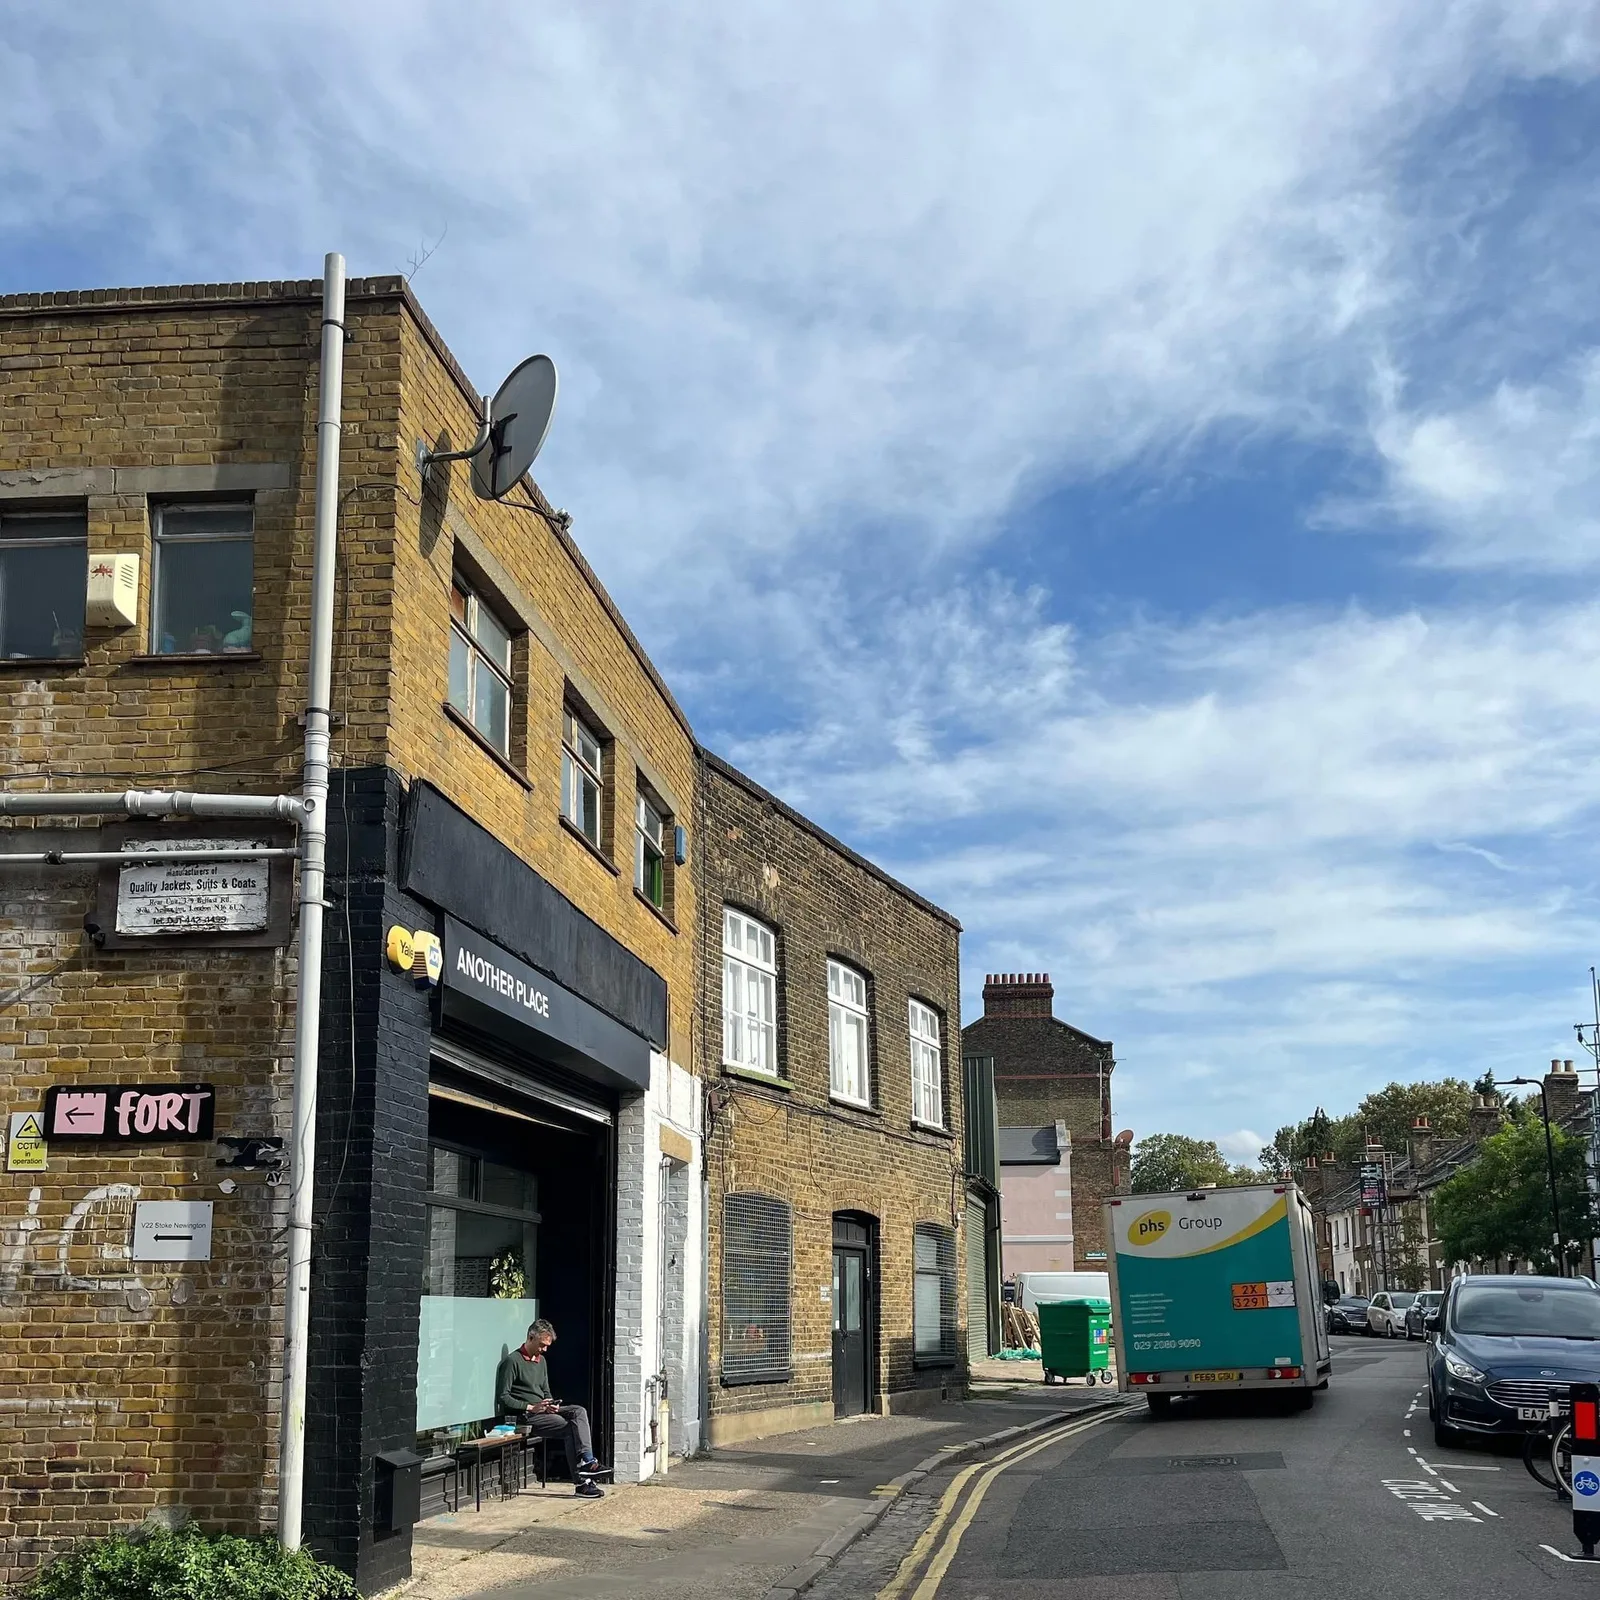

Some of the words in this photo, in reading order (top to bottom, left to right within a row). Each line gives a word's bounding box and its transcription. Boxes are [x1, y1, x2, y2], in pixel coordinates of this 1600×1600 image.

[130, 882, 158, 894] Quality
[161, 880, 194, 892] Jackets,
[197, 879, 218, 890] Suits
[221, 877, 229, 889] &
[232, 877, 257, 889] Coats
[400, 940, 414, 959] Yale
[456, 947, 515, 999] ANOTHER
[516, 979, 550, 1018] PLACE
[17, 1142, 40, 1150] CCTV
[12, 1157, 43, 1165] operation
[174, 1222, 206, 1230] Newington
[1139, 1219, 1165, 1235] phs
[1179, 1217, 1222, 1230] Group
[1241, 1285, 1258, 1295] 2X
[1234, 1297, 1265, 1308] 3291
[1133, 1341, 1151, 1350] 029
[1177, 1338, 1201, 1348] 9090
